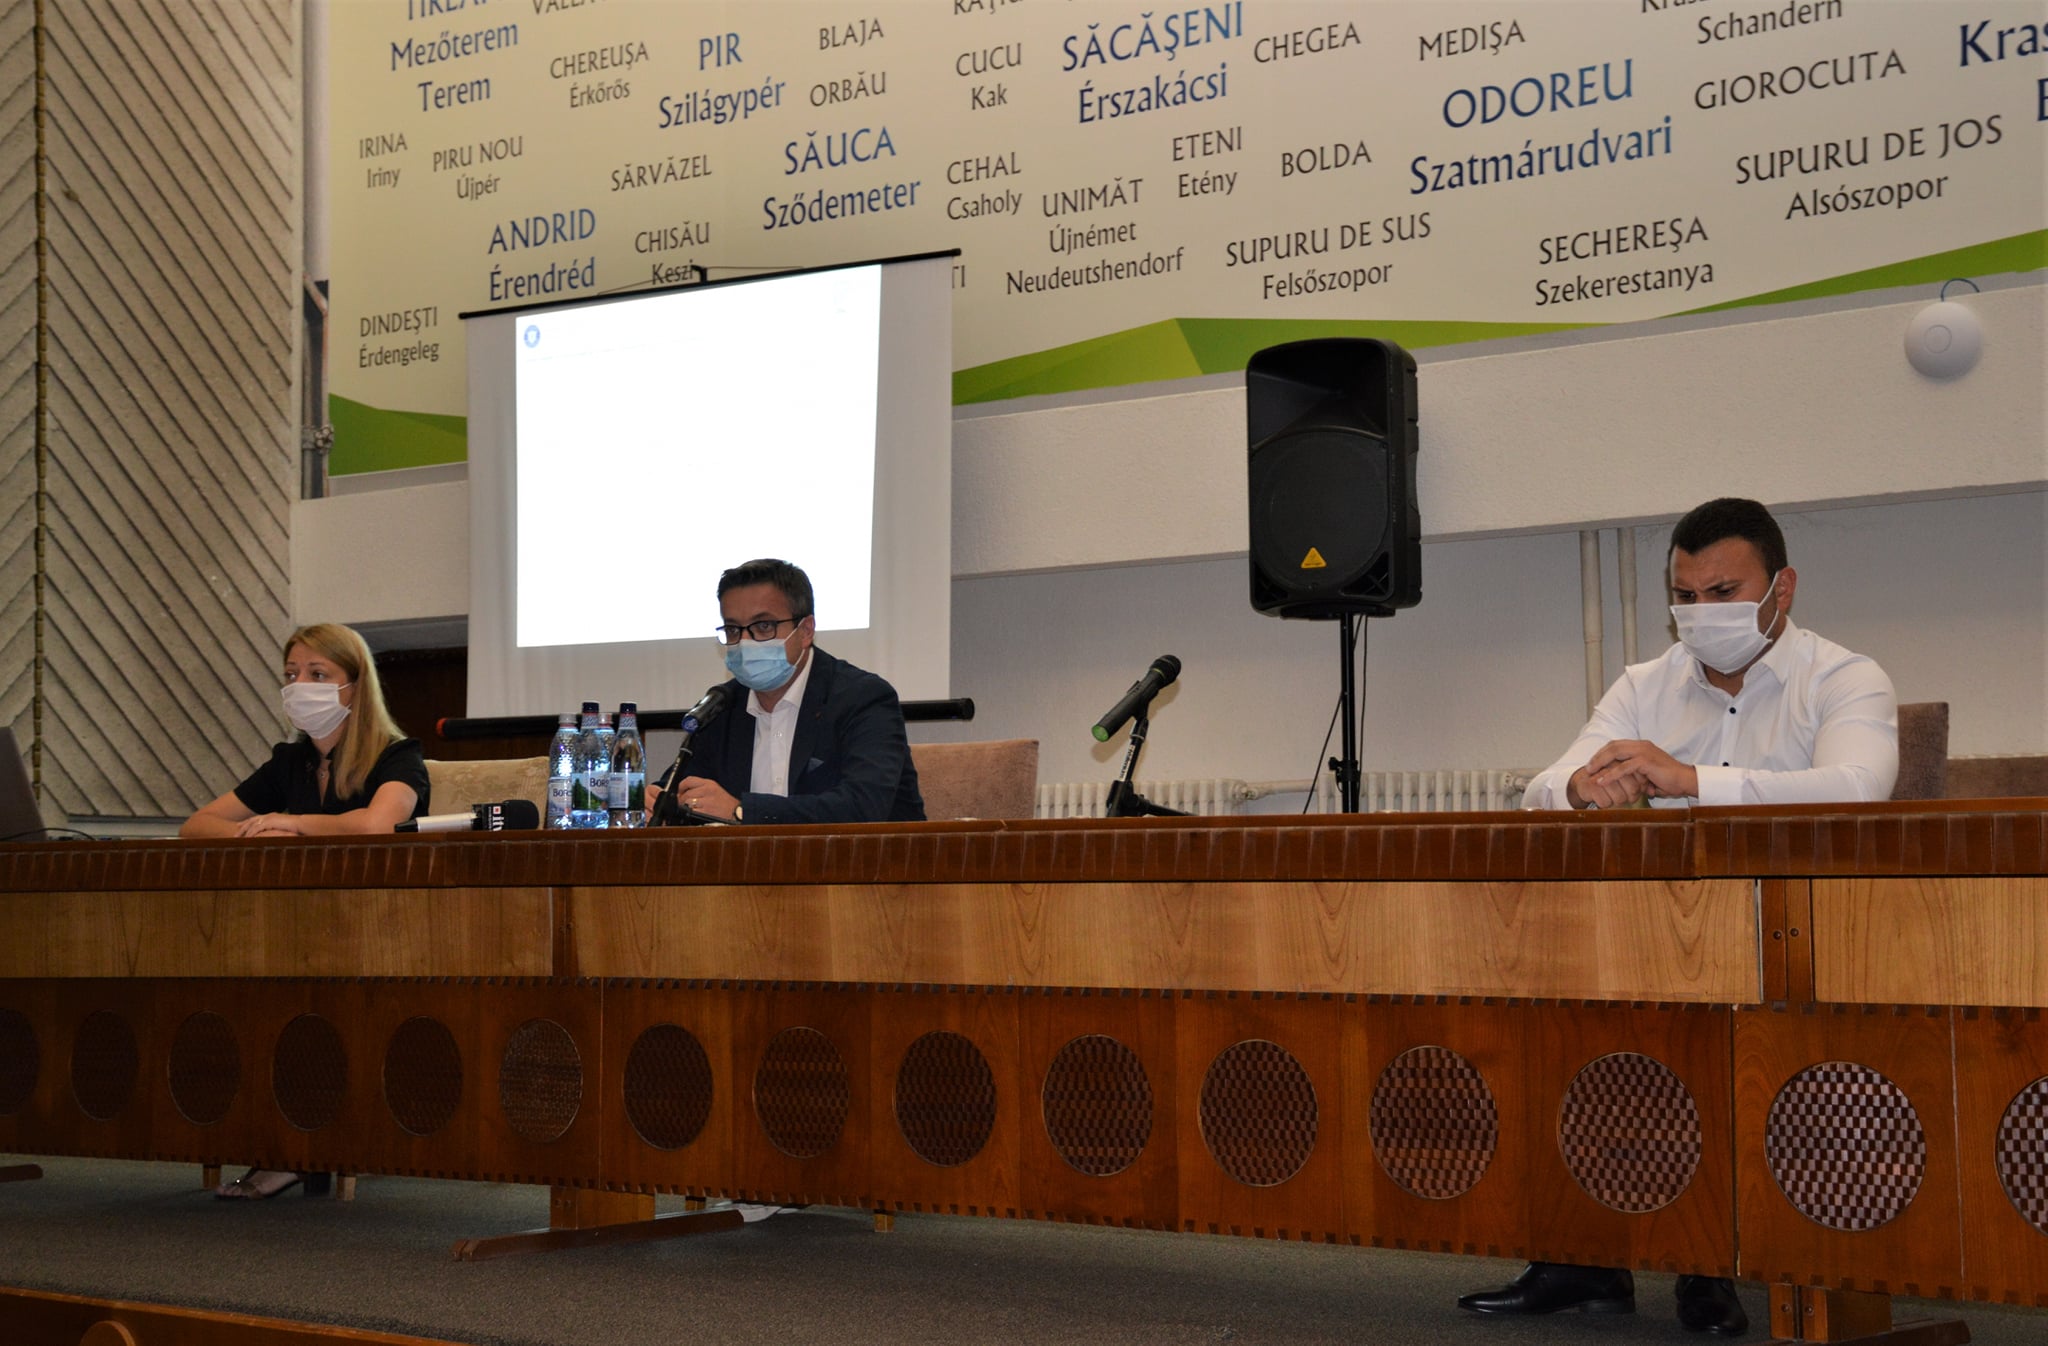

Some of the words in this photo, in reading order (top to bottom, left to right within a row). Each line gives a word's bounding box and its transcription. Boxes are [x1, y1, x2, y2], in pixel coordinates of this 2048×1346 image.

[819, 18, 884, 50] BLAJA
[1063, 1, 1242, 72] SĂCĂŞENI
[1419, 19, 1526, 61] MEDIŞA
[1698, 0, 1842, 44] Schandern
[390, 24, 518, 71] Mezőterem
[550, 42, 649, 79] CHEREUŞA
[699, 32, 742, 71] PIR
[956, 43, 1021, 76] CUCU
[1254, 22, 1361, 63] CHEGEA
[417, 78, 490, 112] Terem
[810, 71, 886, 107] ORBĂU
[972, 83, 1007, 110] Kak
[1079, 62, 1226, 123] Érszakácsi
[1443, 58, 1632, 128] ODOREU
[1694, 49, 1907, 109] GIOROCUTA
[659, 76, 786, 129] Szilágypér
[360, 133, 408, 159] IRINA
[433, 145, 472, 172] PIRU
[480, 136, 522, 163] NOU
[785, 126, 896, 175] SĂUCA
[1173, 126, 1242, 162] ETENI
[1282, 140, 1372, 177] BOLDA
[1410, 115, 1671, 195] Szatmárudvari
[1736, 136, 1868, 184] SUPURU
[1884, 127, 1926, 161] DE
[1938, 114, 2002, 158] JOS
[457, 174, 500, 200] Újpér
[611, 155, 712, 191] SĂRVĂZEL
[947, 152, 1021, 184] CEHAL
[1179, 170, 1238, 198] Etény
[763, 181, 921, 230] Sződemeter
[947, 189, 1022, 220] Csaholy
[1043, 177, 1143, 217] UNIMĂT
[1785, 176, 1949, 220] Alsószopor
[488, 209, 595, 254] ANDRID
[635, 221, 709, 253] CHISĂU
[1050, 222, 1136, 255] Újnémet
[1226, 228, 1328, 267] SUPURU
[1340, 221, 1372, 250] DE
[1382, 212, 1431, 243] SUS
[1539, 216, 1709, 265] SECHEREŞA
[490, 257, 595, 301] Érendréd
[652, 259, 693, 285] Keszi
[1006, 246, 1184, 295] Neudeutshendorf
[1263, 264, 1392, 300] Felsőszopor
[1536, 264, 1713, 306] Szekerestanya
[360, 306, 437, 337] DINDEŞTI
[360, 341, 439, 368] Érdengeleg
